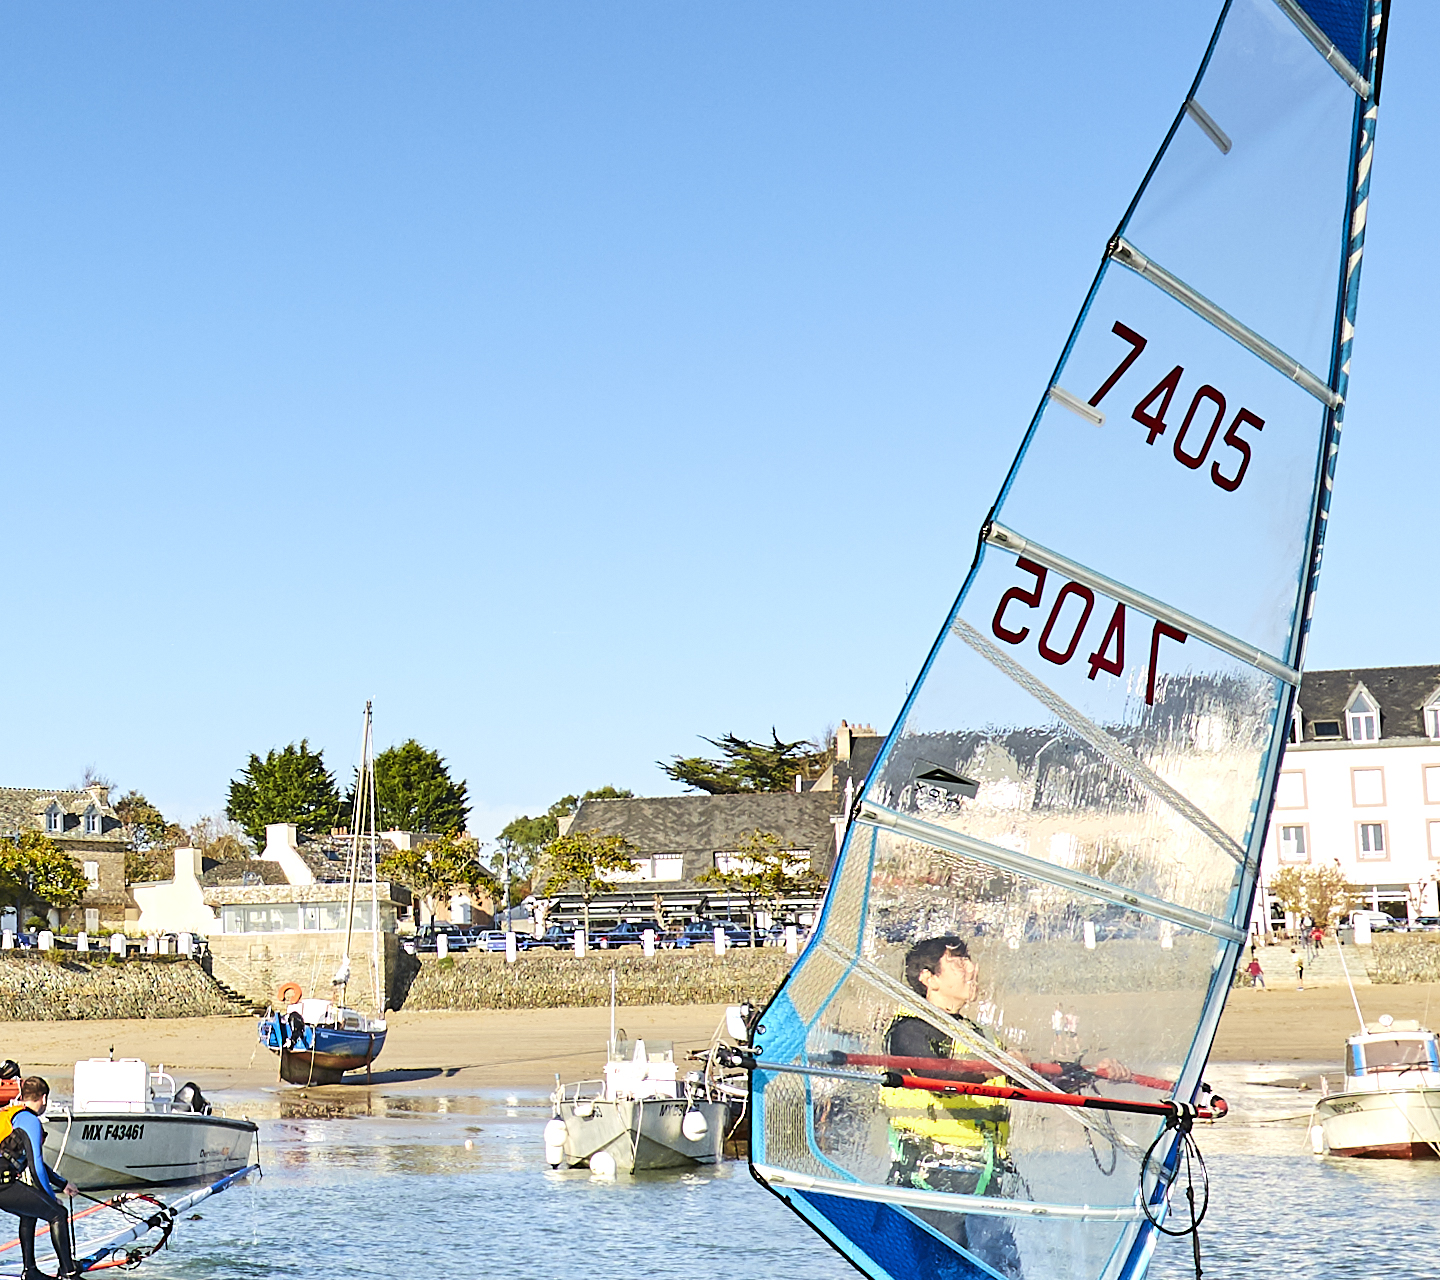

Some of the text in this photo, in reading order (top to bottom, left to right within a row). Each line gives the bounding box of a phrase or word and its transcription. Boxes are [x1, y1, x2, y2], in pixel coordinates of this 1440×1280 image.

[1087, 320, 1265, 493] 7405
[81, 1123, 145, 1141] MX F43461
